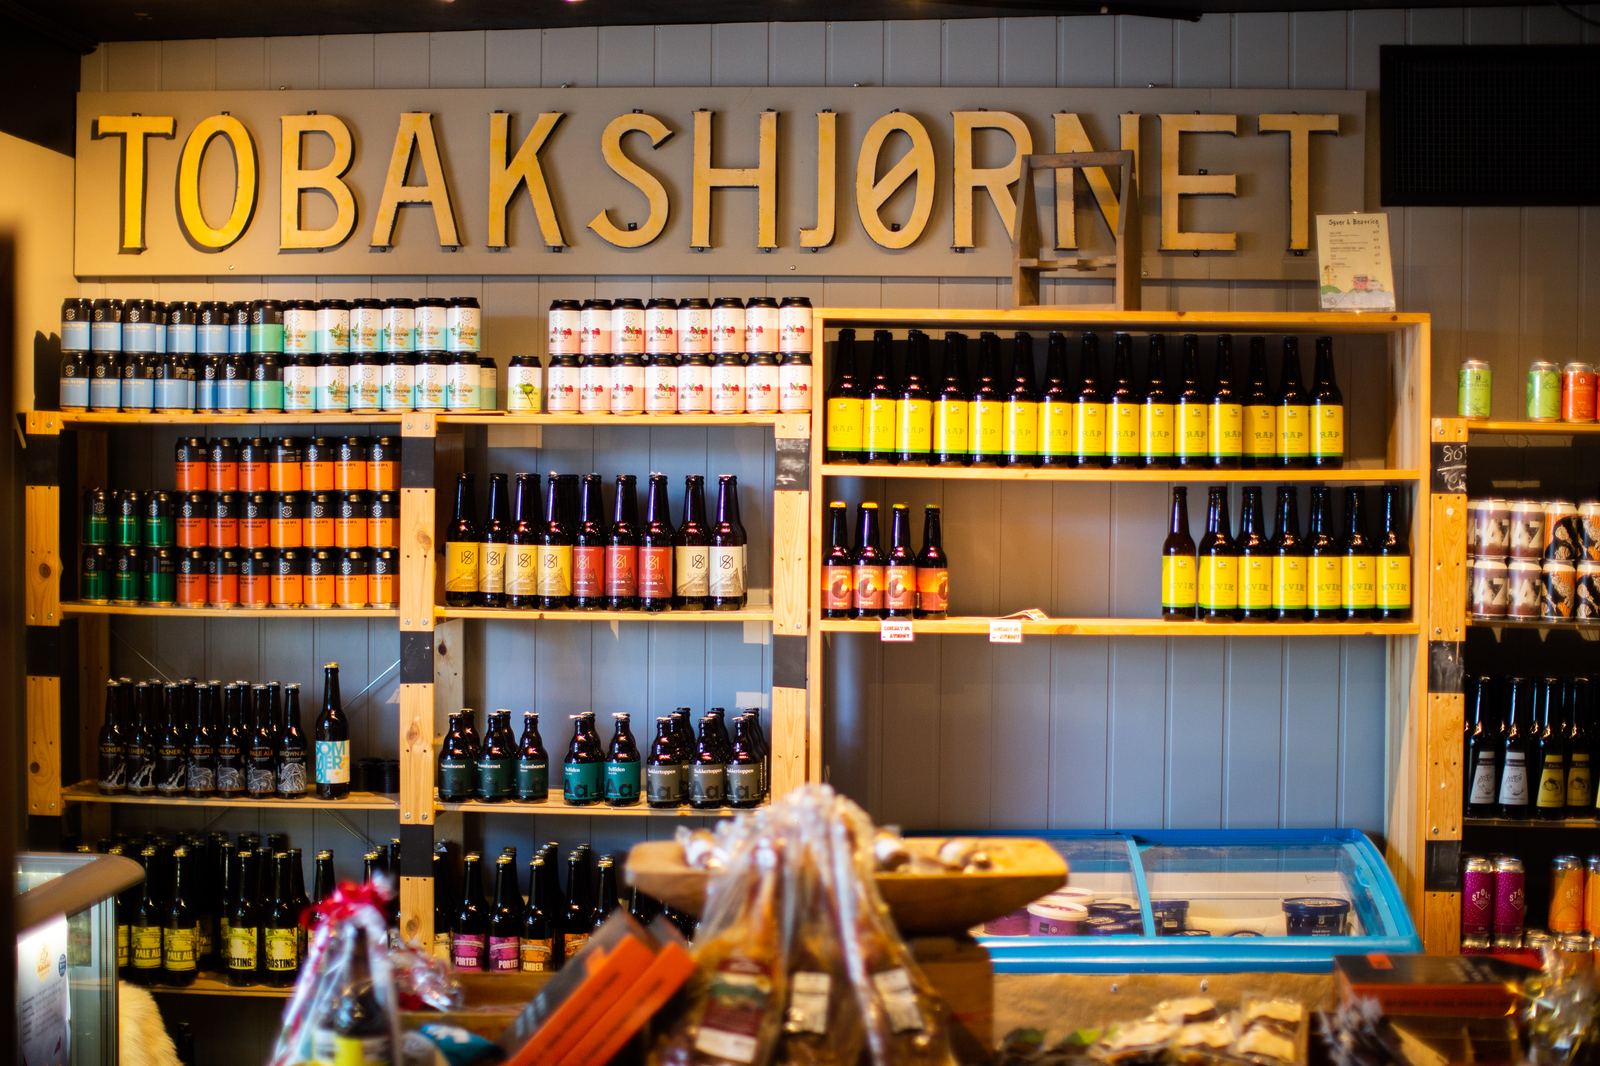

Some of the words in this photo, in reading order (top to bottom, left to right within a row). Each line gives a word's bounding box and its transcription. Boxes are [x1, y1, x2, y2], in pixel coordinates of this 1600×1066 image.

[96, 108, 1340, 251] TOBAKSHJØRNET
[135, 948, 151, 959] PALE
[167, 950, 182, 961] PALE
[455, 956, 477, 967] PORTER
[522, 961, 544, 972] AMBER
